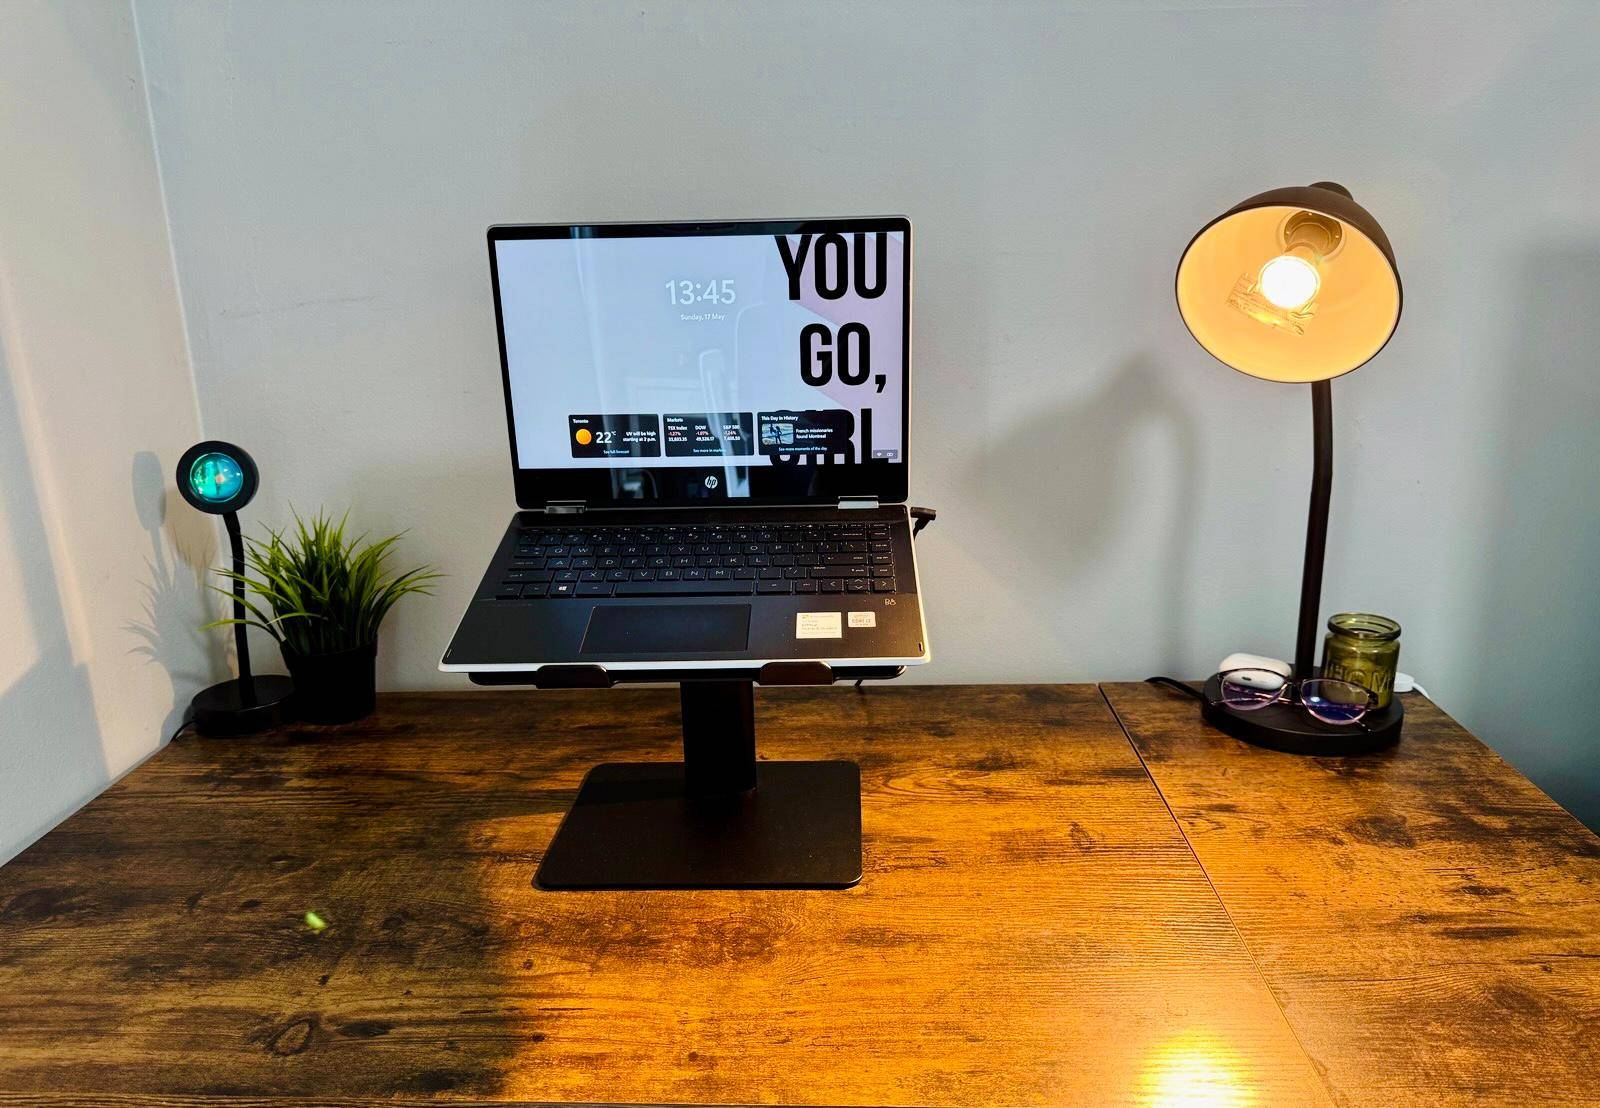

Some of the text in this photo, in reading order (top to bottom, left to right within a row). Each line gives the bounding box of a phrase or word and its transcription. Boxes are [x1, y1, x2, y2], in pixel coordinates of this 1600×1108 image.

[774, 232, 887, 300] YOU
[665, 279, 736, 304] 13:45
[712, 312, 727, 321] May
[800, 322, 887, 393] GO,
[704, 475, 718, 489] hp
